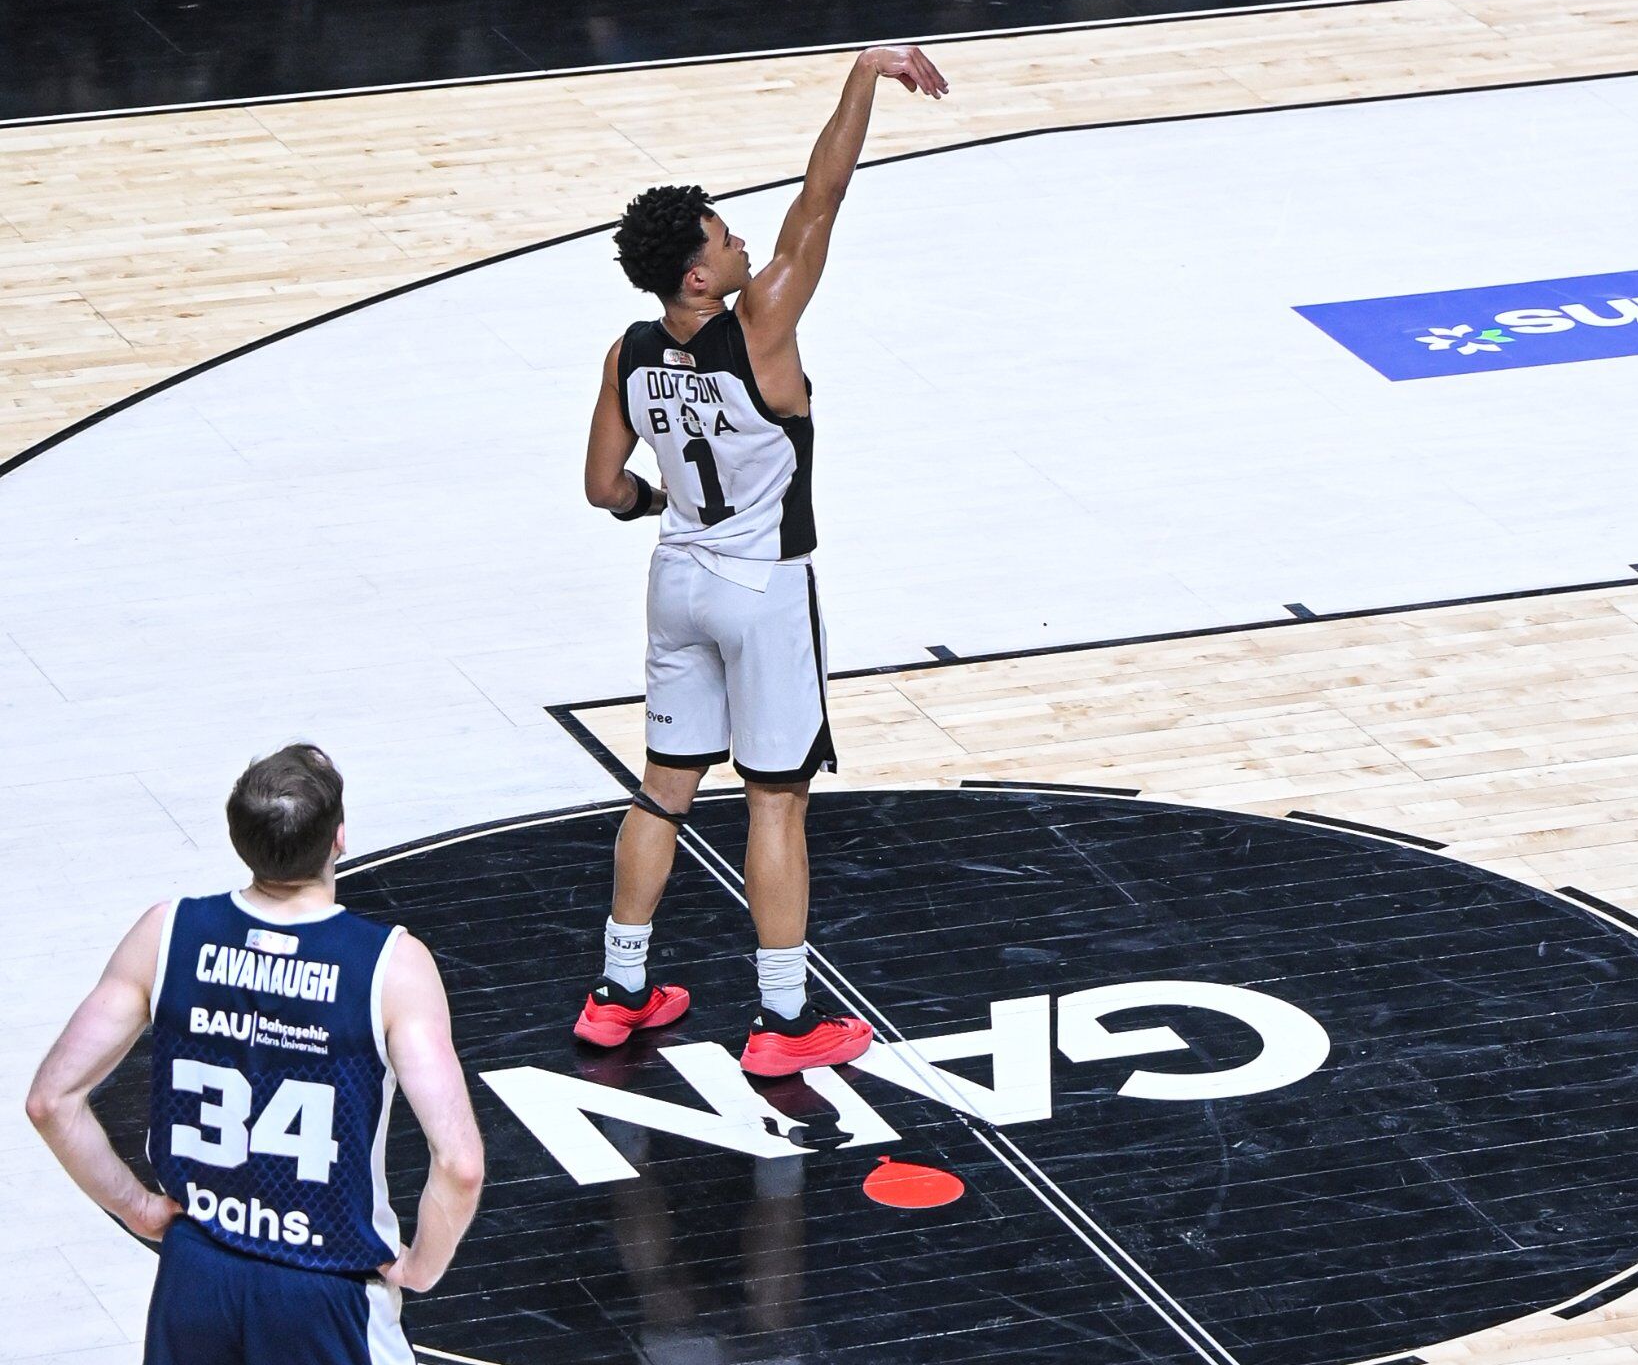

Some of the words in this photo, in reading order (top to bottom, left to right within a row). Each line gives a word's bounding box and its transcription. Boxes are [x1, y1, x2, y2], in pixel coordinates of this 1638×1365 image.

[647, 370, 725, 404] DOTSON
[682, 438, 736, 526] 1
[196, 943, 340, 1003] CAVANAUGH
[189, 1006, 252, 1041] BAU
[170, 1058, 339, 1185] 34
[185, 1181, 324, 1247] bahs.
